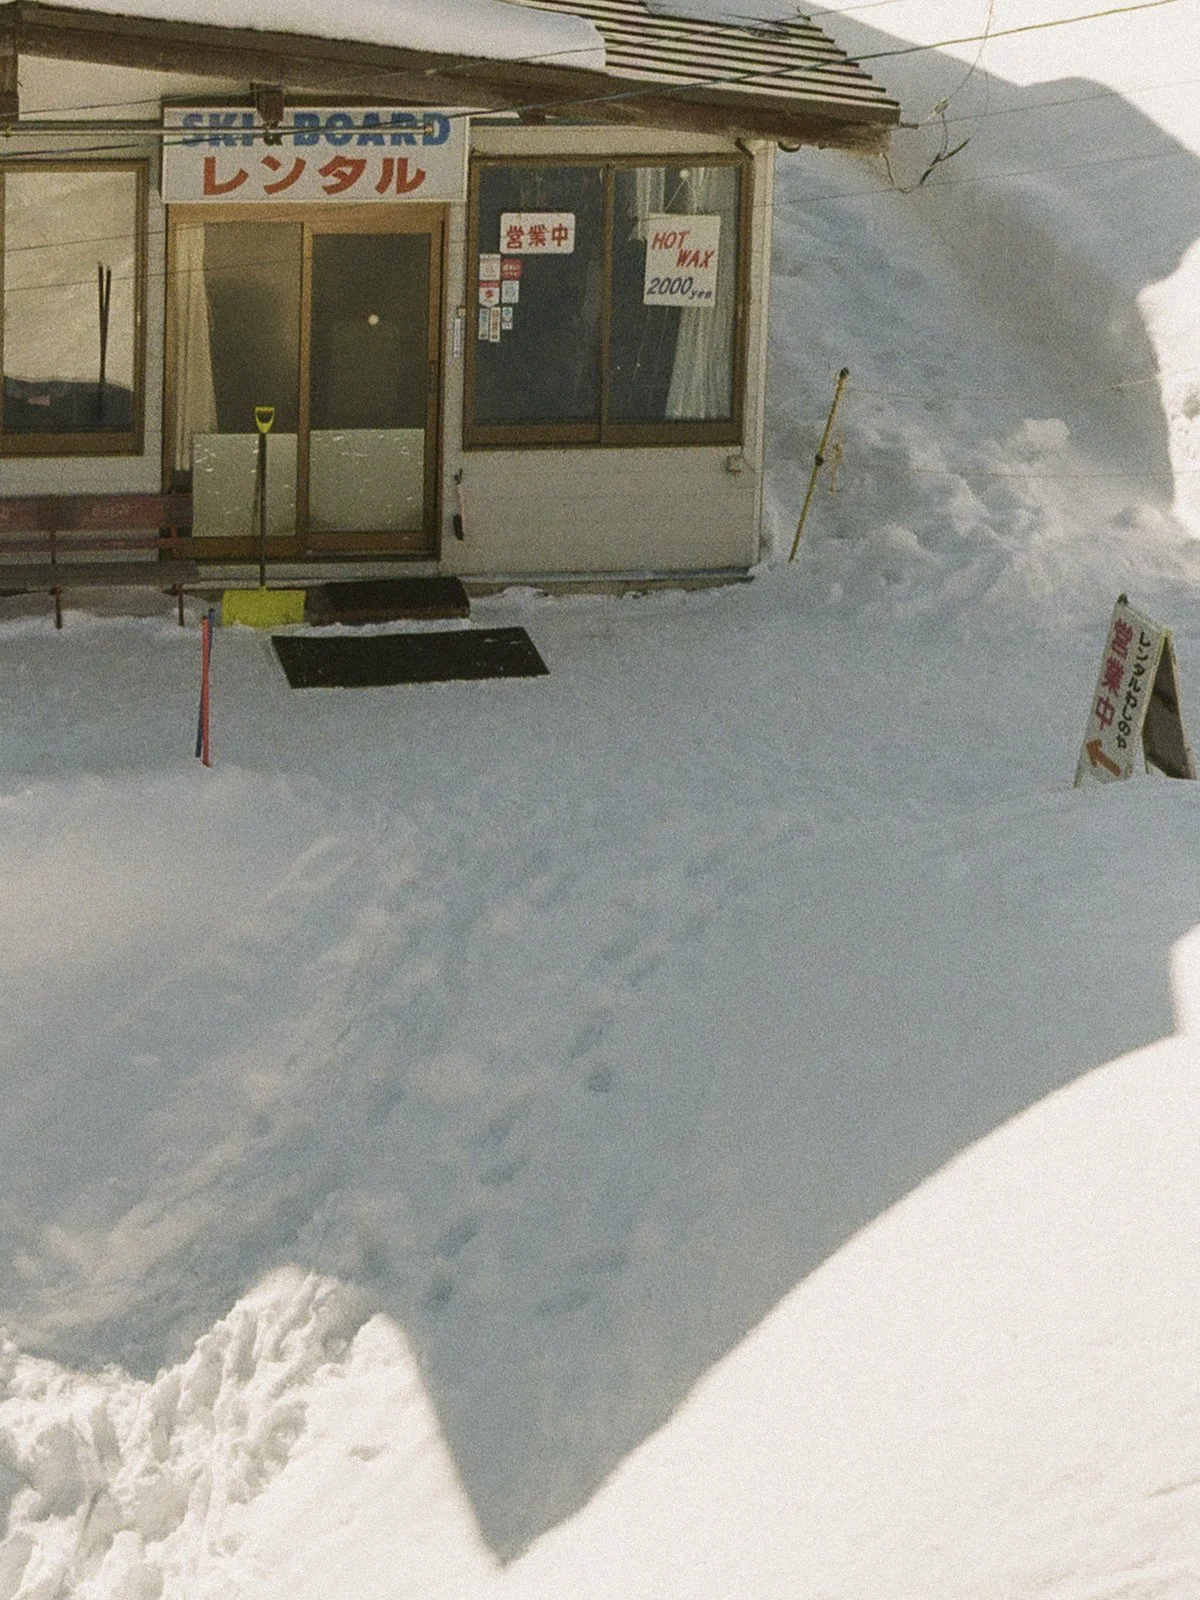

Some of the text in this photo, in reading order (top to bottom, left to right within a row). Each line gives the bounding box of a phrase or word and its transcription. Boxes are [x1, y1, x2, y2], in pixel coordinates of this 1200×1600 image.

[203, 155, 426, 196] レンタル
[506, 223, 569, 250] 営業中
[652, 230, 690, 250] HOT
[676, 250, 715, 269] WAX
